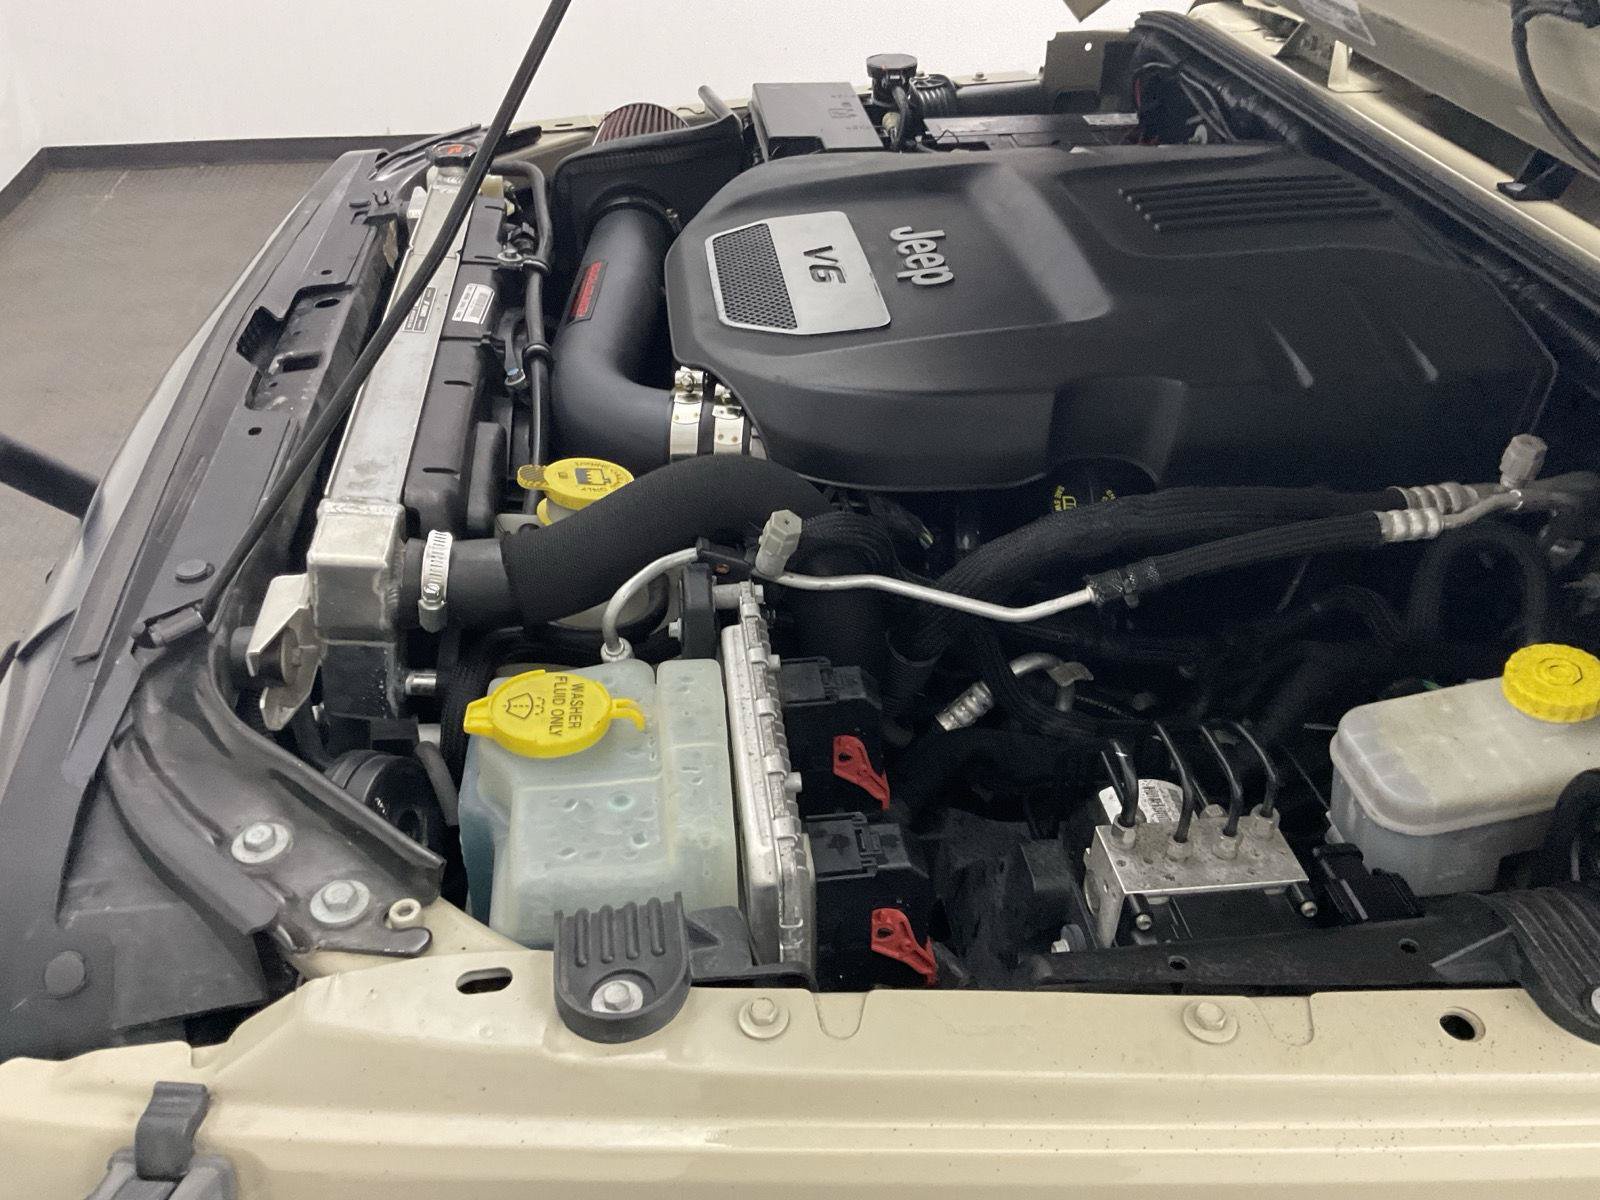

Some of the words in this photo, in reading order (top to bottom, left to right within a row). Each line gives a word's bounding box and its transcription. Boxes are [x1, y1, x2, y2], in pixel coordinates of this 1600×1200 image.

[803, 245, 846, 284] V6
[889, 226, 955, 286] Jeep
[552, 676, 567, 705] FLUID
[569, 683, 584, 728] WASHER
[549, 709, 565, 736] ONLY
